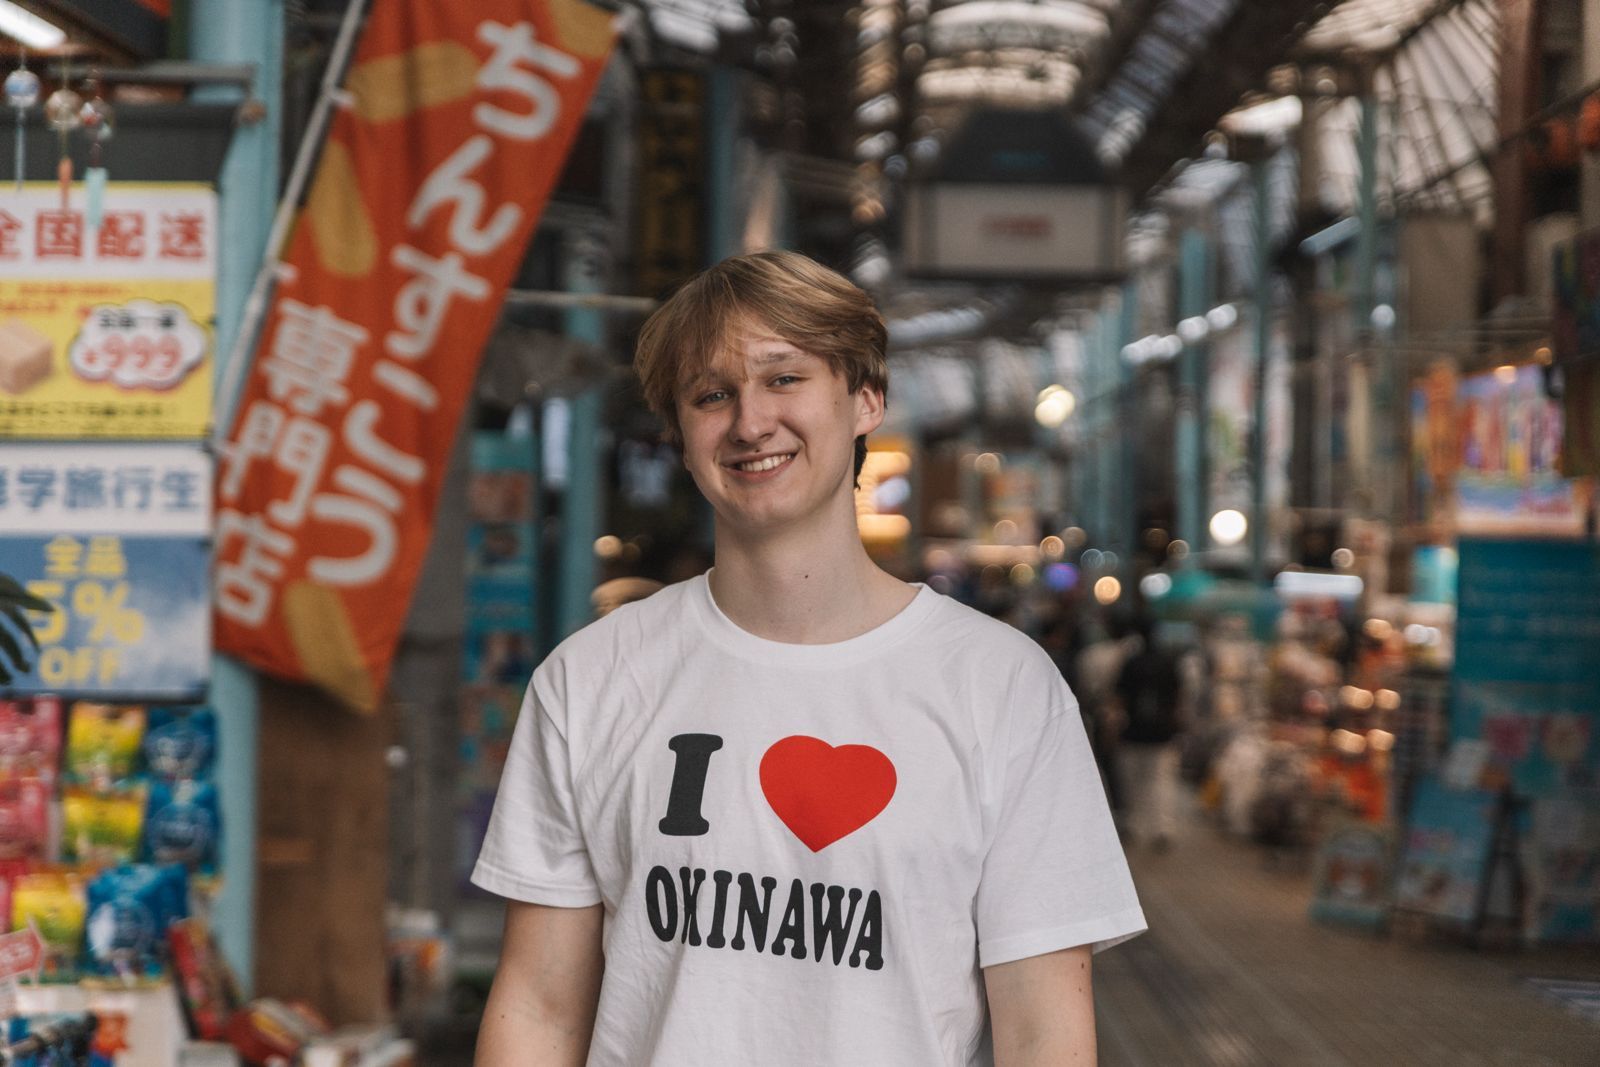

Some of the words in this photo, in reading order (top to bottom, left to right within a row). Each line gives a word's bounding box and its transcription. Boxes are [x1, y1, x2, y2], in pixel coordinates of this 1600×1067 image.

[308, 20, 582, 587] ちんすこう
[0, 467, 200, 512] 学旅行生
[215, 297, 370, 627] 専門店
[44, 536, 126, 576] 全品
[26, 580, 145, 644] 5%
[38, 646, 121, 687] OFF
[658, 733, 723, 836] I
[645, 865, 884, 971] OKINAWA
